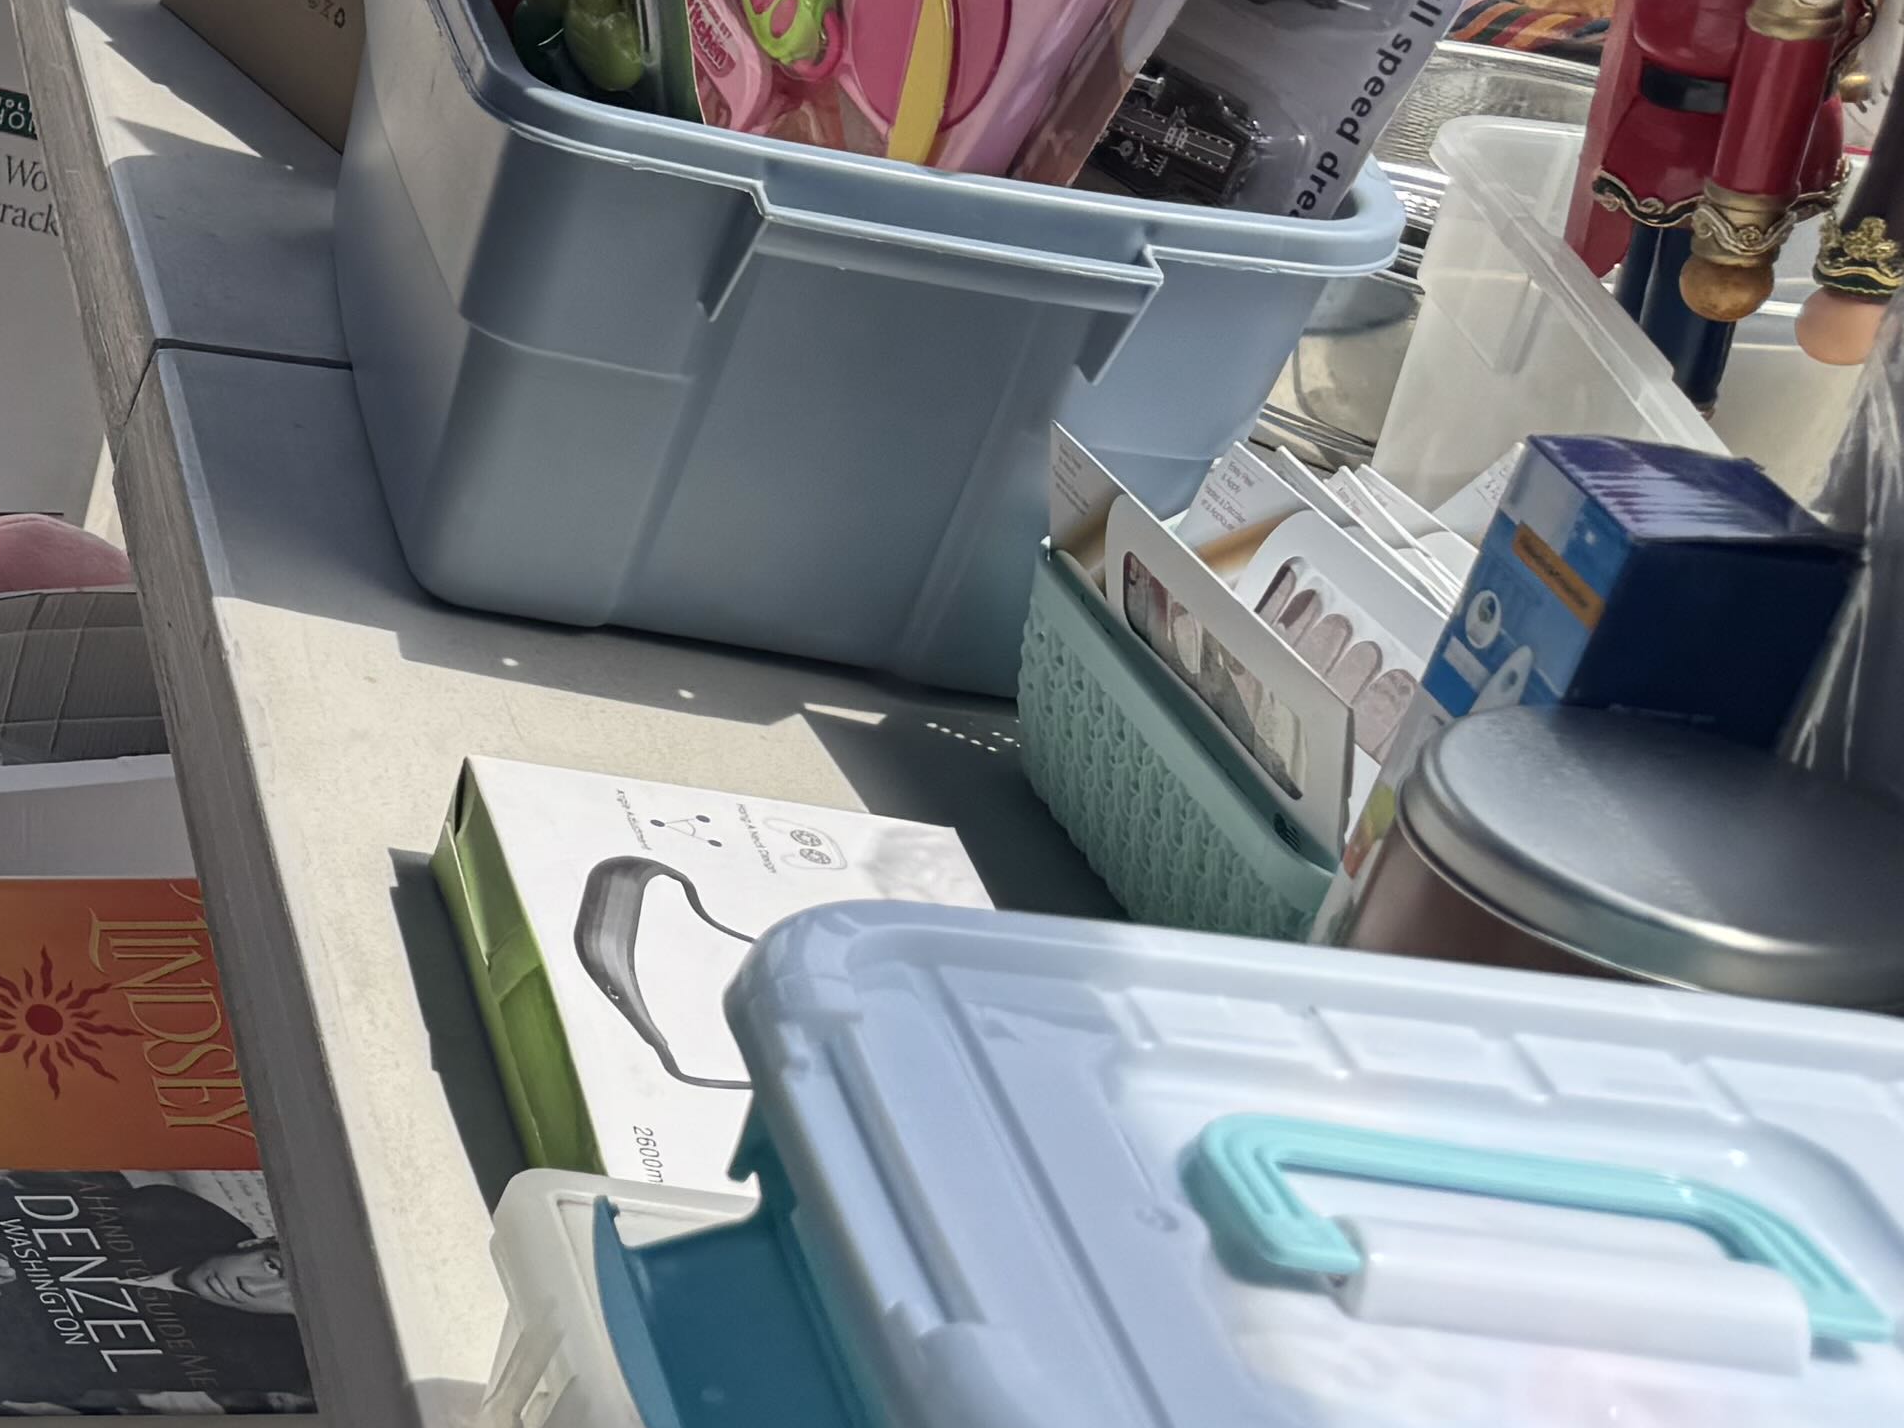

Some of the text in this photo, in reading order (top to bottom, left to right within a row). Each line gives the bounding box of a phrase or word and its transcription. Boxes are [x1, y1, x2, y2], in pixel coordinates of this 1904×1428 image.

[1335, 32, 1415, 148] speed
[4, 160, 49, 194] Wo
[1292, 148, 1350, 217] drea
[88, 906, 258, 1139] LINDSEY
[0, 1217, 91, 1347] WASHINGTON
[13, 1194, 164, 1373] DENZEL
[89, 1198, 135, 1255] HAND
[137, 1287, 195, 1352] GUIDE
